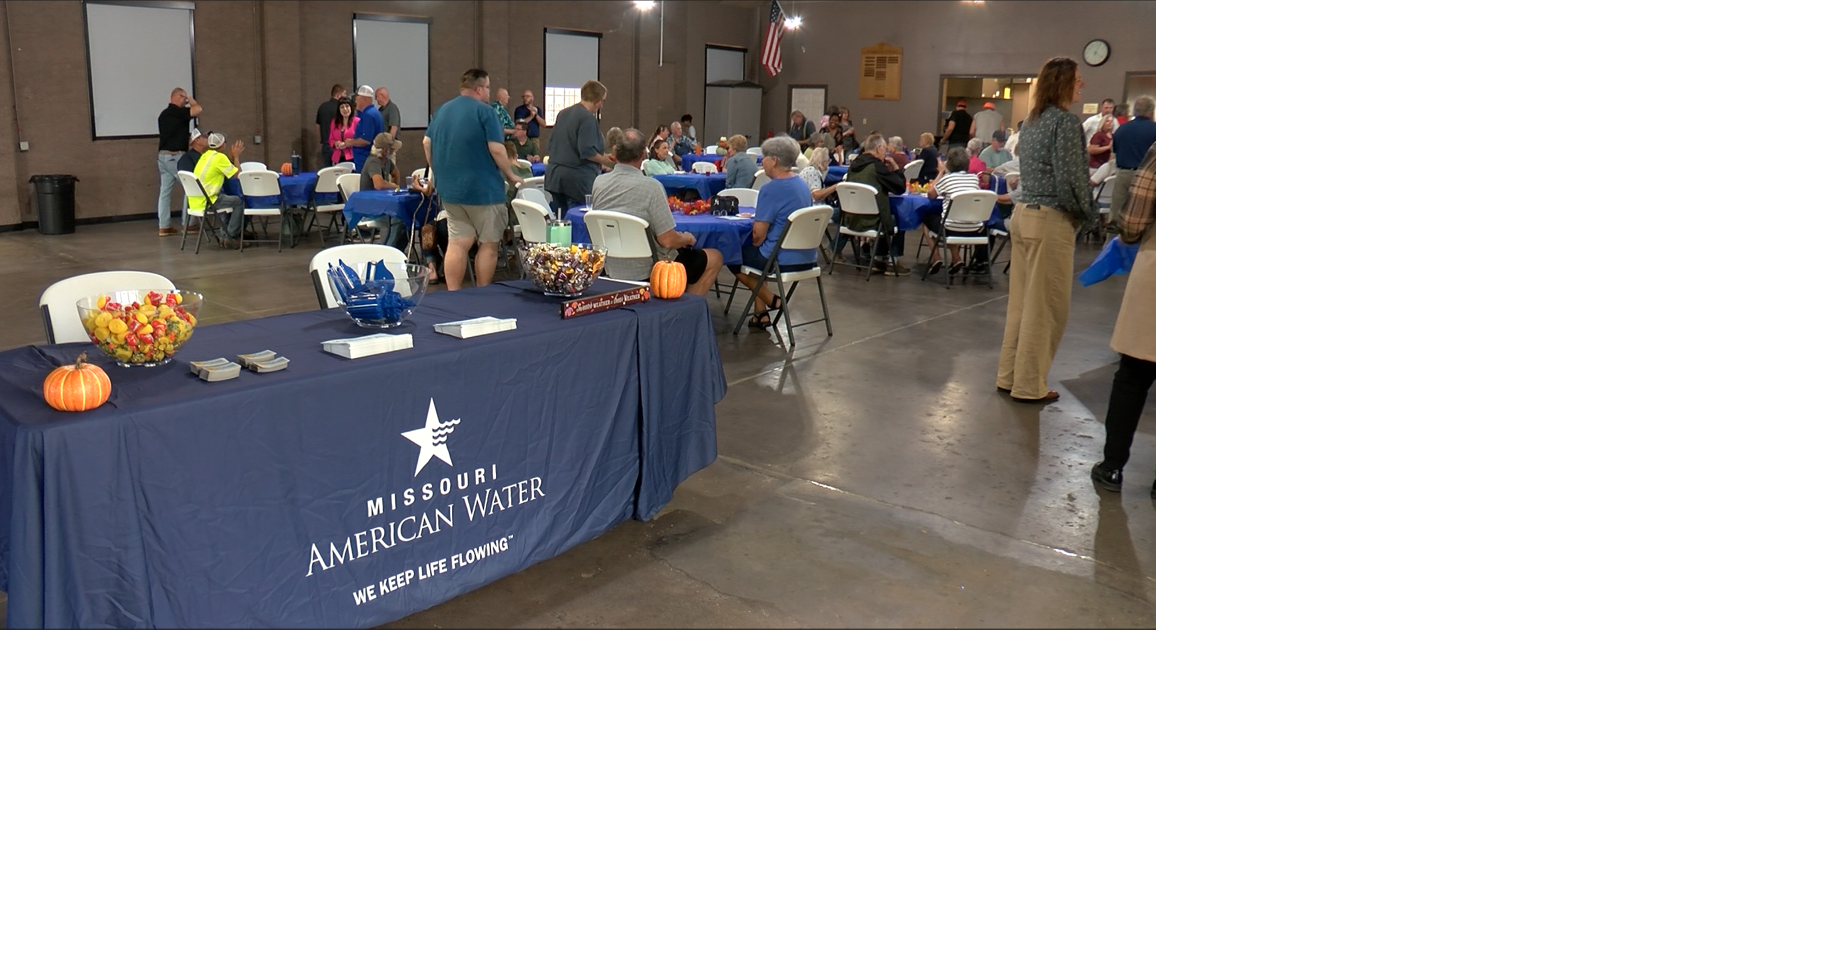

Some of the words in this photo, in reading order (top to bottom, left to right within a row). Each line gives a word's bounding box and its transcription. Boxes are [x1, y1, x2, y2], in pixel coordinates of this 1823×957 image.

[368, 464, 497, 517] MISSOURI
[305, 505, 454, 577] AMERICAN
[463, 476, 545, 521] WATER
[353, 585, 377, 606] WE
[380, 570, 415, 595] KEEP
[418, 559, 448, 580] LIFE
